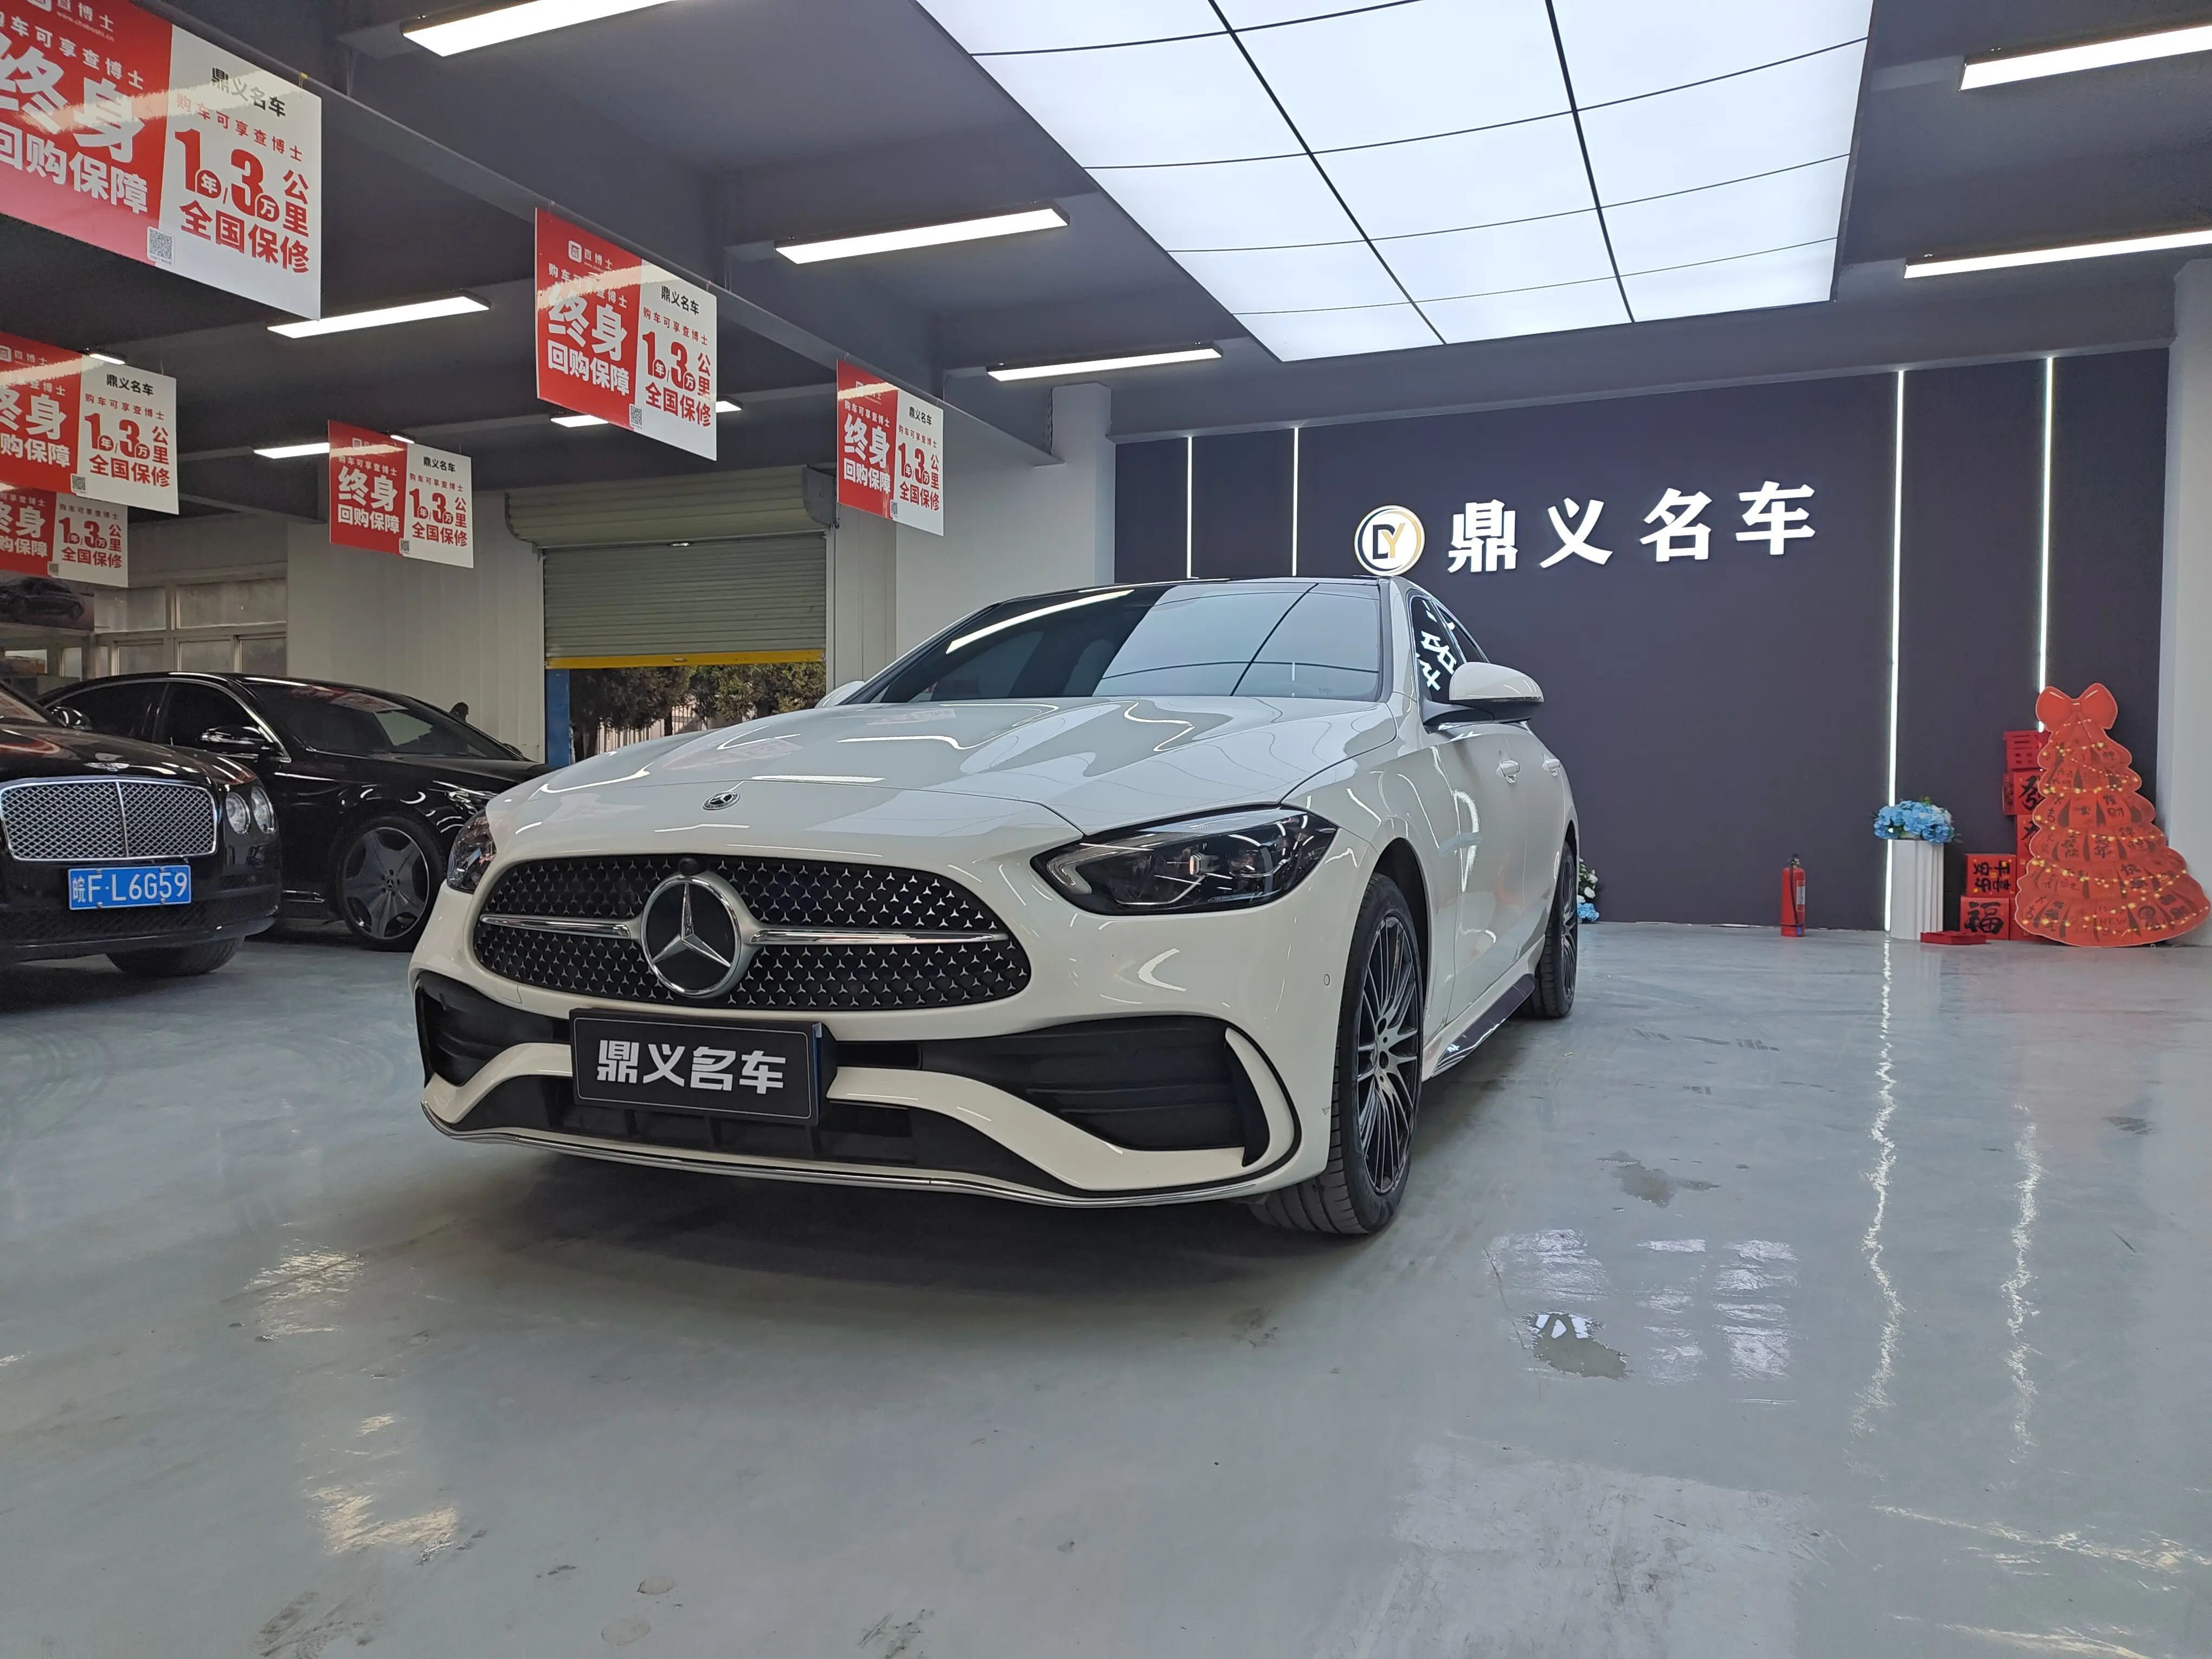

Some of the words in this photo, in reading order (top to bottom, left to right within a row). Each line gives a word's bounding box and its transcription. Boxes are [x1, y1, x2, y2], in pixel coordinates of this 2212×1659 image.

[0, 11, 144, 90] 车可享查博士
[211, 67, 286, 118] 鼎义名车
[176, 93, 303, 162] 购车可享查博士
[179, 200, 310, 274] 全国保修
[661, 285, 699, 316] 鼎义名车
[548, 284, 628, 362] 终身
[642, 306, 709, 346] 购车可享查博士
[106, 373, 154, 396] 鼎义名车
[548, 339, 629, 396] 回购保障
[85, 393, 165, 421] 购车可享查博士
[646, 381, 711, 427] 全国保修
[909, 406, 933, 427] 鼎义名车
[844, 413, 890, 468] 终身
[898, 424, 937, 448] 购车可享查博士
[89, 454, 170, 488] 全国保修
[423, 456, 456, 473] 鼎义名车
[844, 457, 891, 494] 回购保障
[338, 466, 398, 512] 终身
[409, 473, 464, 492] 购车可享查博士
[899, 480, 940, 511] 全国保修
[338, 504, 400, 534] 回购保障
[411, 521, 468, 547] 全国保修
[1447, 480, 1816, 574] 鼎义名车
[61, 546, 123, 569] 全国保修
[1964, 901, 2004, 935] 福
[597, 1039, 786, 1095] 鼎义名车
